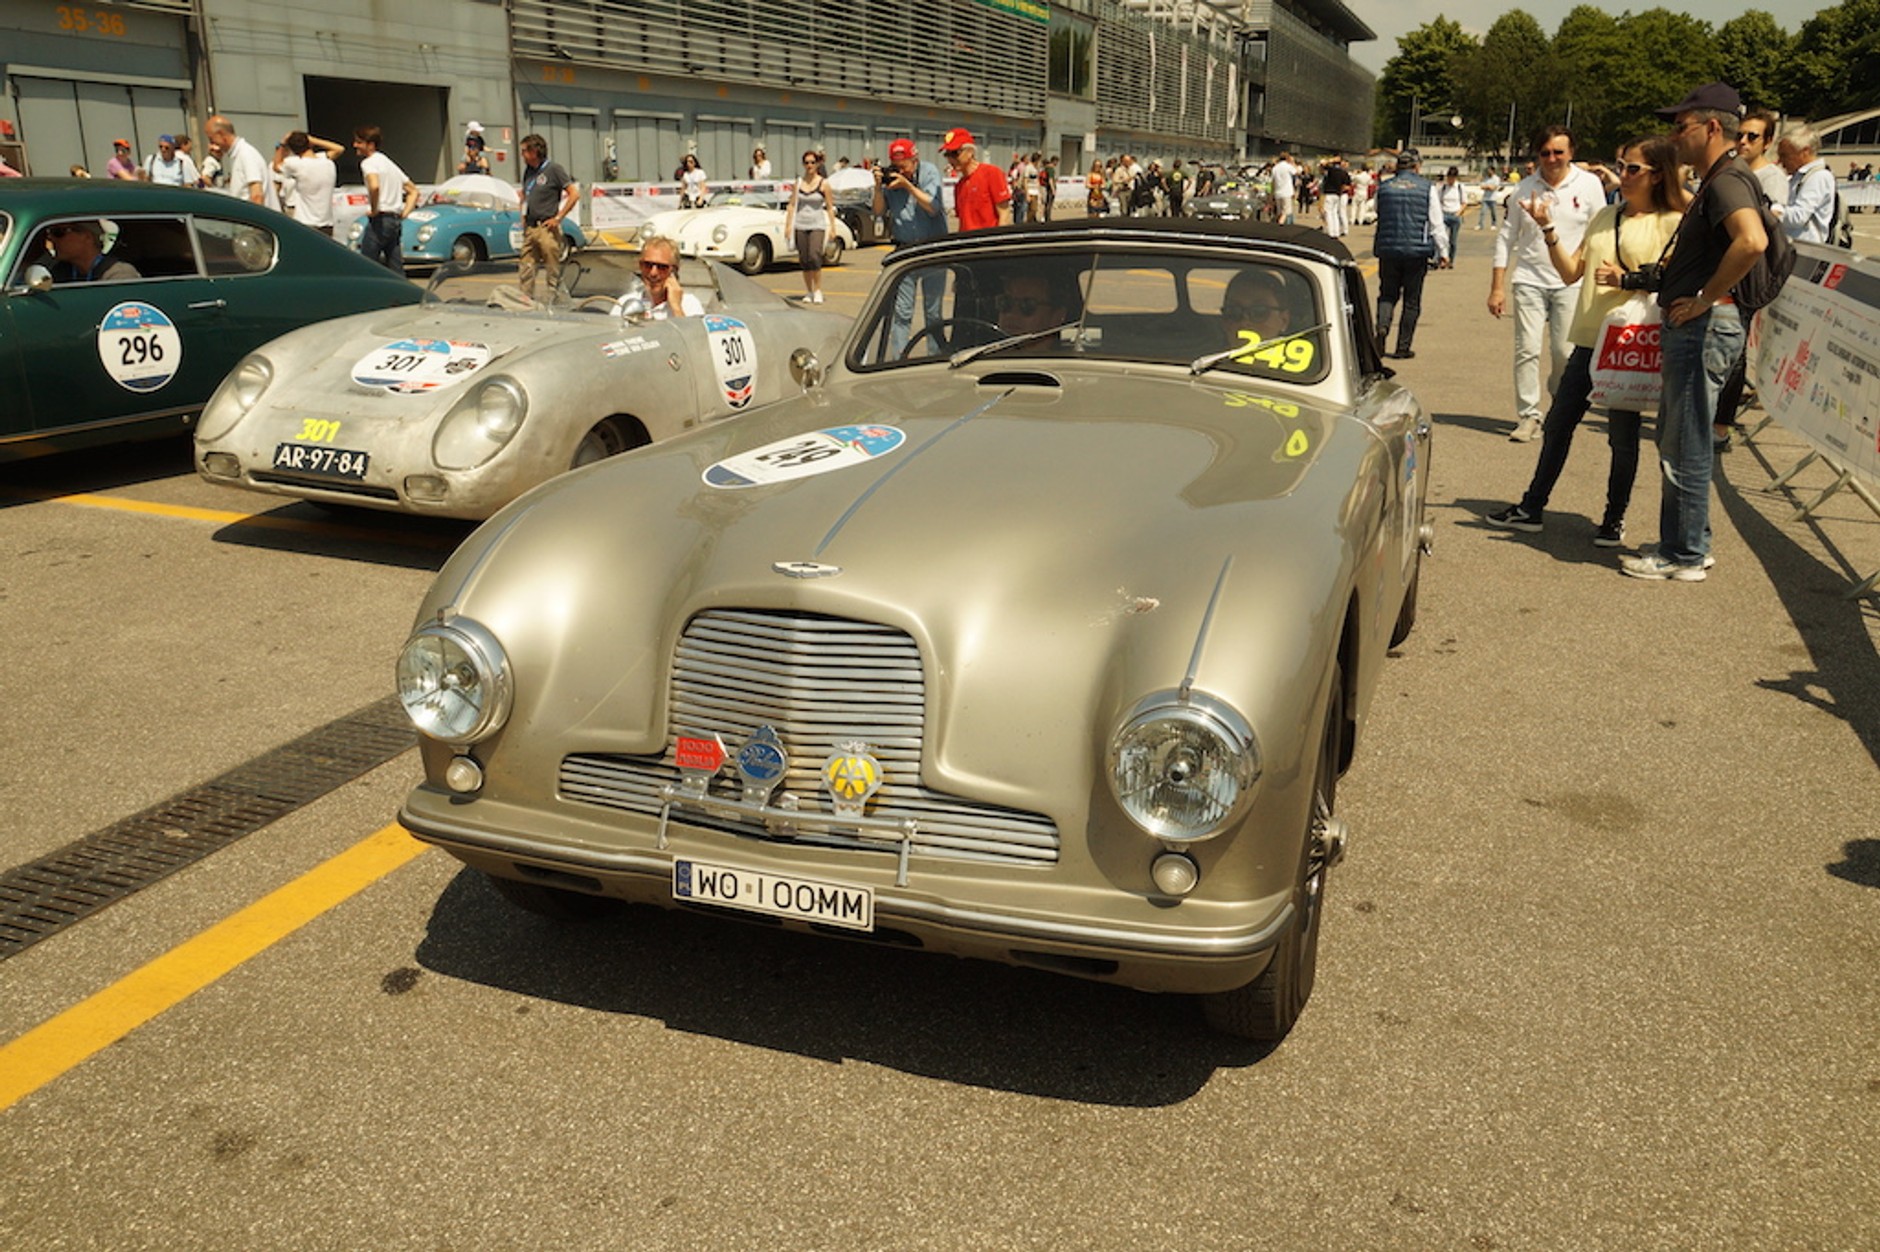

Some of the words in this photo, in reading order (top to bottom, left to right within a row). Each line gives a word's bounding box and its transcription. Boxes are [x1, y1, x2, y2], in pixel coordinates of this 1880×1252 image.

[56, 6, 127, 37] 35-36
[118, 333, 164, 366] 296
[375, 354, 427, 373] 301
[721, 335, 747, 366] 301
[1229, 330, 1315, 373] 249
[295, 418, 341, 443] 301
[275, 445, 366, 476] AR-97-84
[681, 740, 714, 753] 1000
